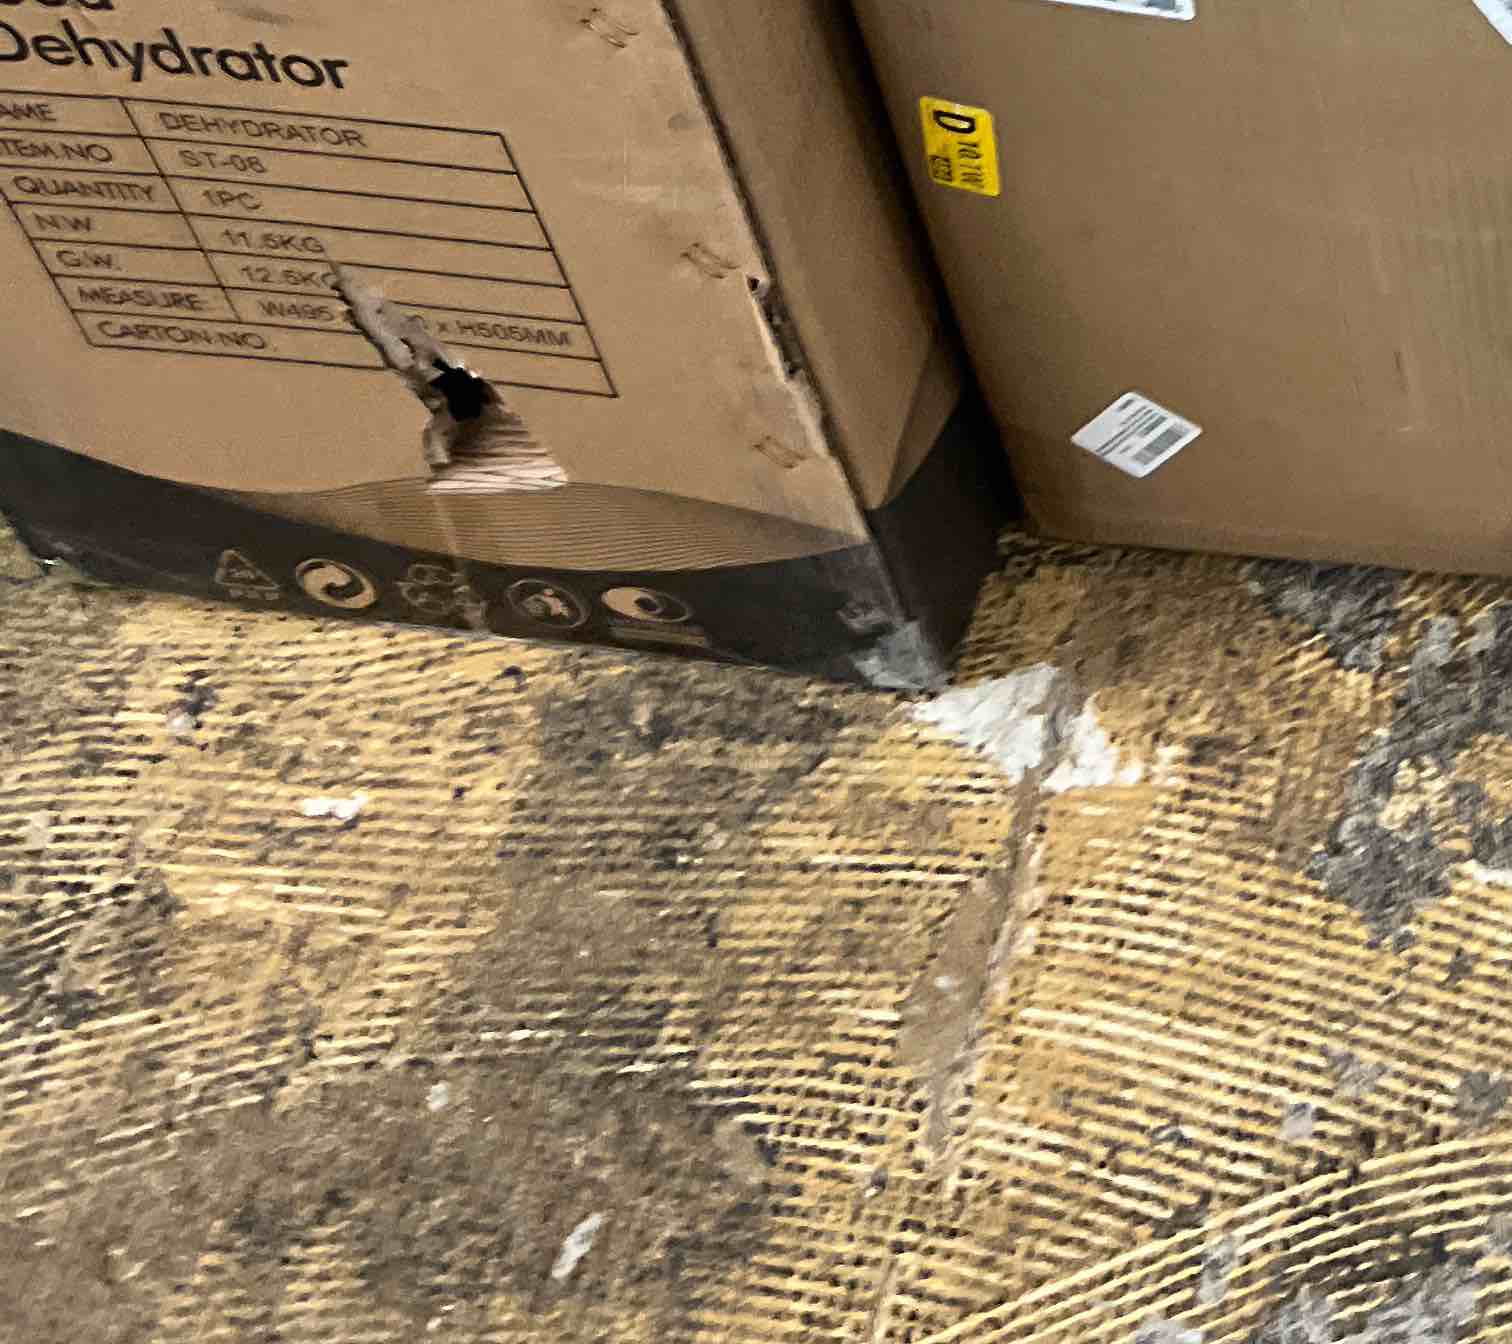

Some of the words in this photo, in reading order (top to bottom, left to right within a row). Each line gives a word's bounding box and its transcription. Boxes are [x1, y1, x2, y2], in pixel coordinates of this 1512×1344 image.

[0, 18, 349, 90] Dehydrator
[157, 111, 368, 148] DEHYDRATOR
[12, 175, 155, 202] QUANTITY
[78, 285, 206, 312] MEASURE
